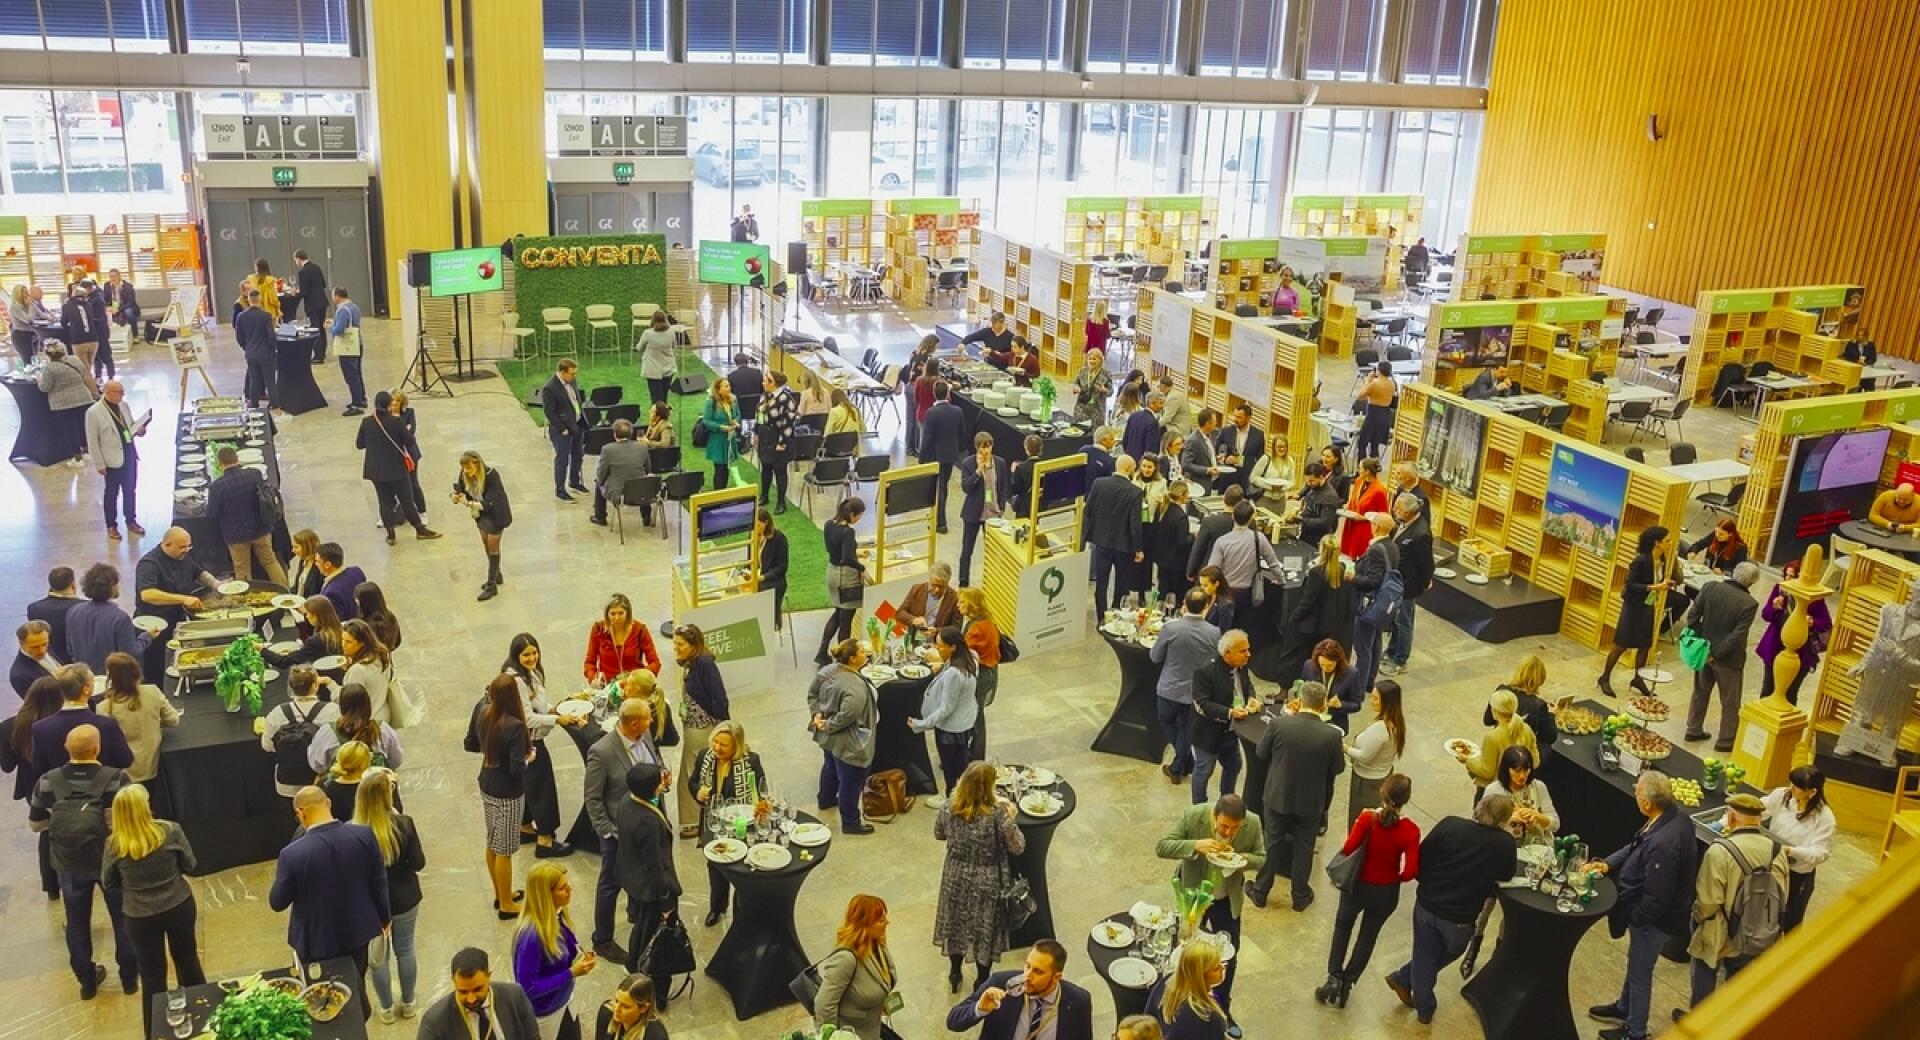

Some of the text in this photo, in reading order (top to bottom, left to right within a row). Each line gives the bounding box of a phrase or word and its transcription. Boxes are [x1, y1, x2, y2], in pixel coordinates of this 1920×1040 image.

[255, 124, 271, 148] A
[293, 124, 306, 148] C
[601, 124, 614, 145] A
[634, 124, 645, 145] C
[521, 244, 662, 269] CONVENTA
[1717, 299, 1729, 310] 27
[1448, 312, 1461, 323] 29
[1792, 414, 1804, 428] 19
